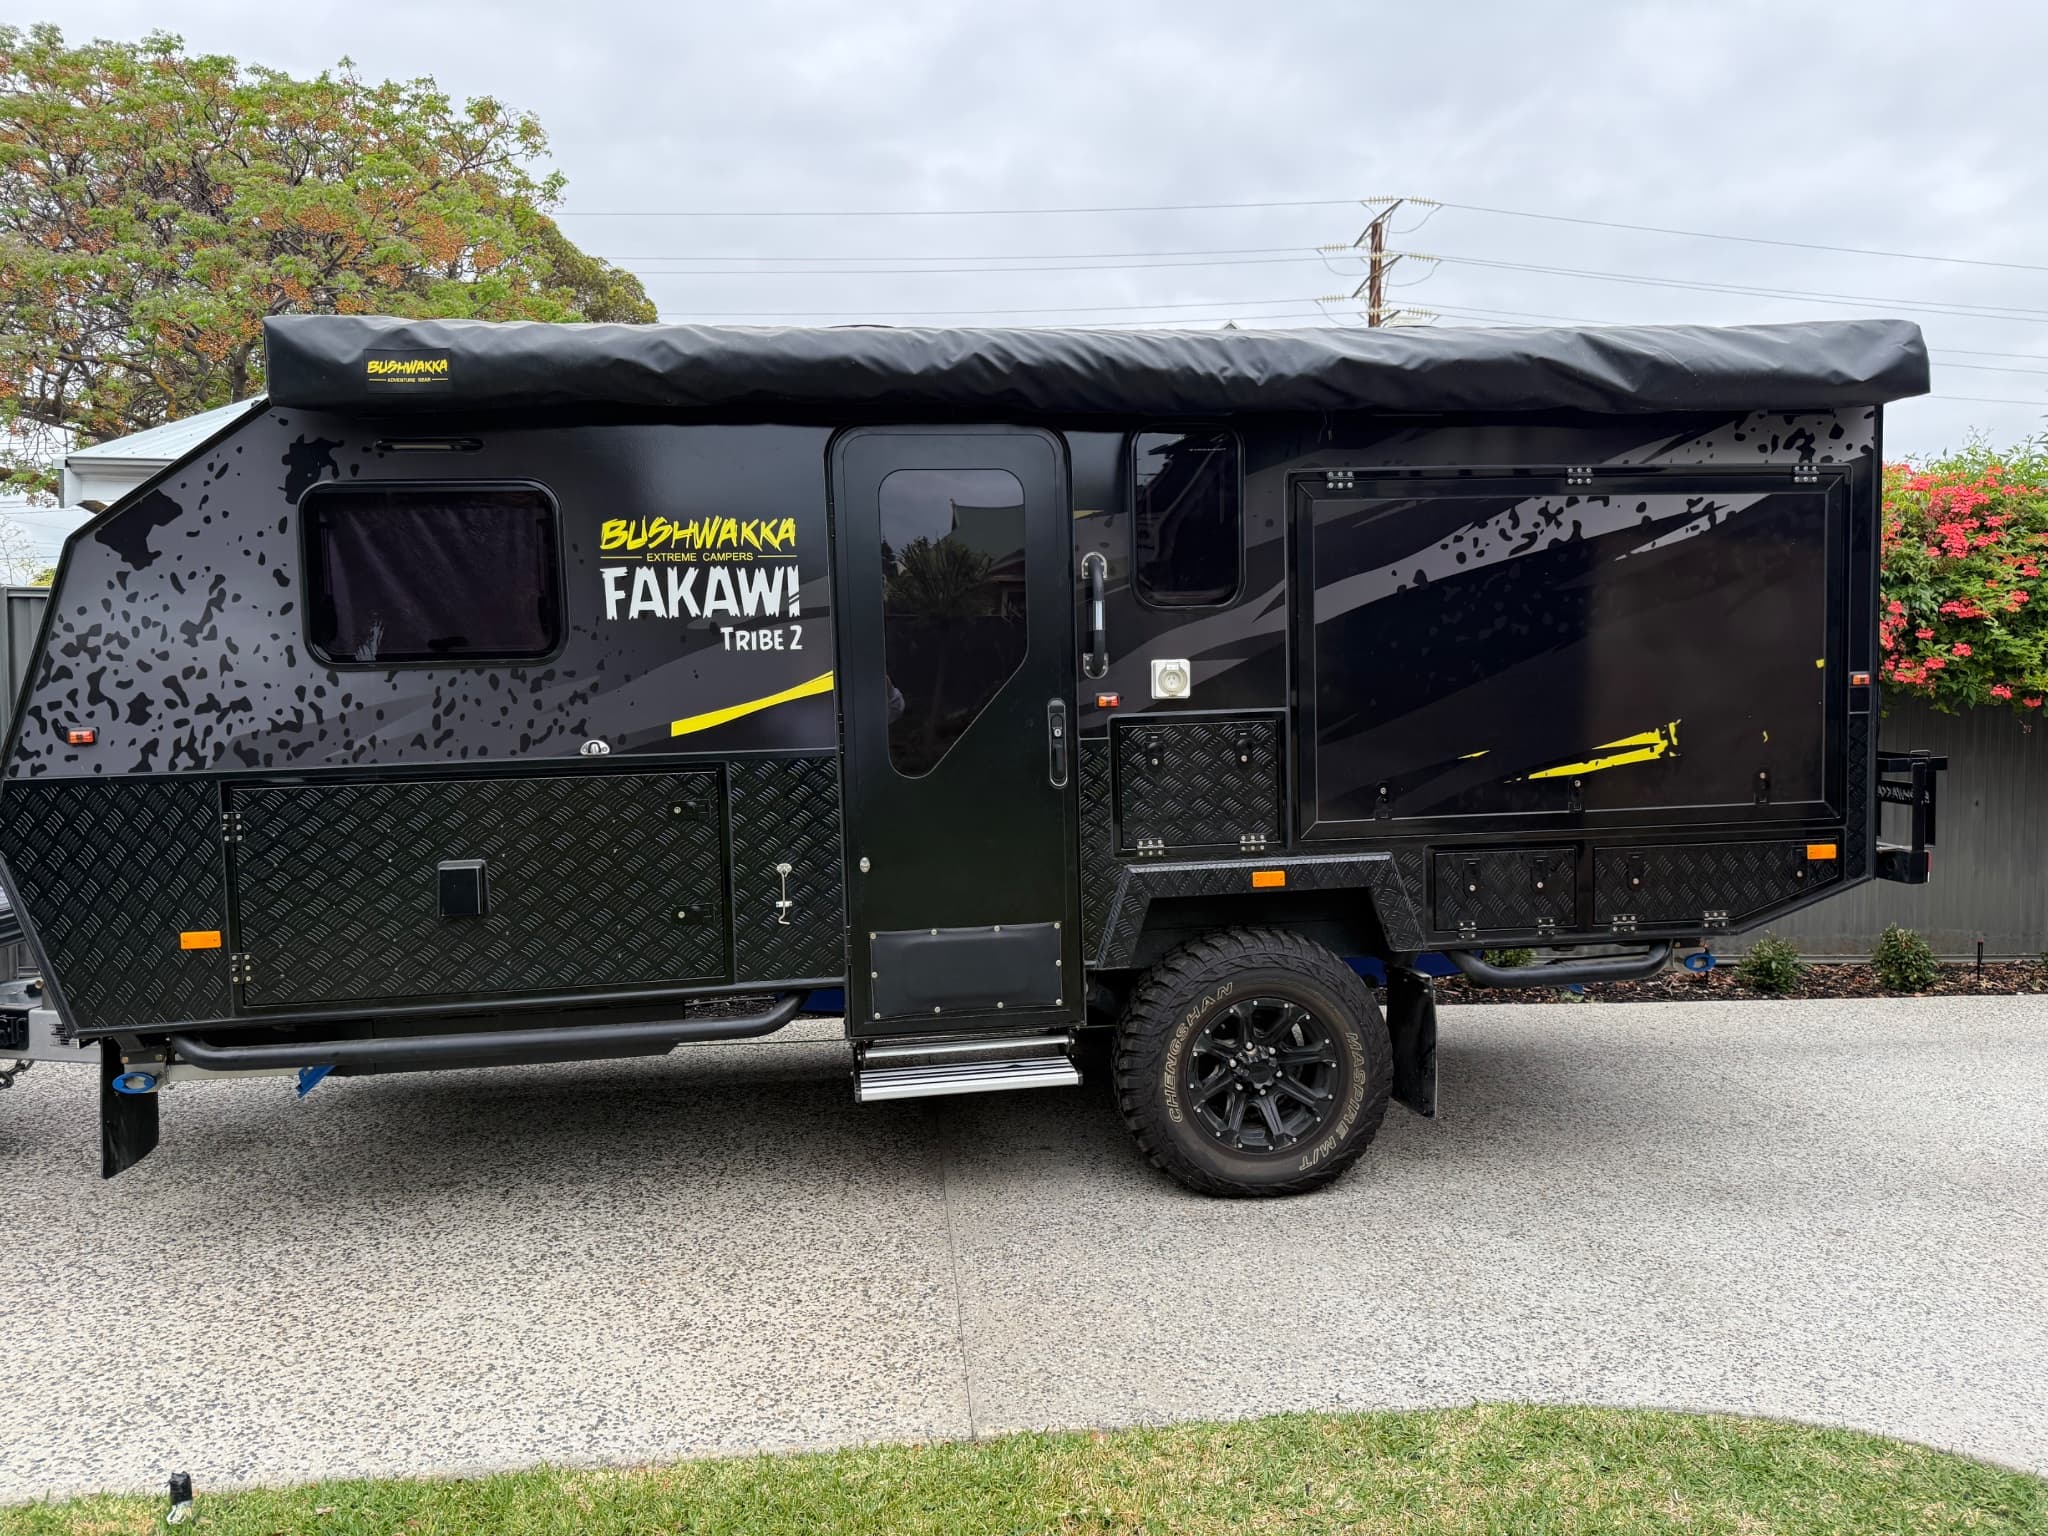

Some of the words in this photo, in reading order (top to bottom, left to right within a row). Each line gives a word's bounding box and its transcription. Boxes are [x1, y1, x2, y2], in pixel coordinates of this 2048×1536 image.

[367, 359, 448, 375] BUSHWAKKA
[600, 514, 796, 551] BUSHWAKKA
[646, 553, 697, 562] EXTREME
[702, 552, 754, 562] CAMPERS
[720, 626, 784, 651] TRIBE
[789, 625, 803, 650] 2
[1163, 981, 1233, 1123] CHENGSHAN
[1338, 1031, 1367, 1140] MASPIRE
